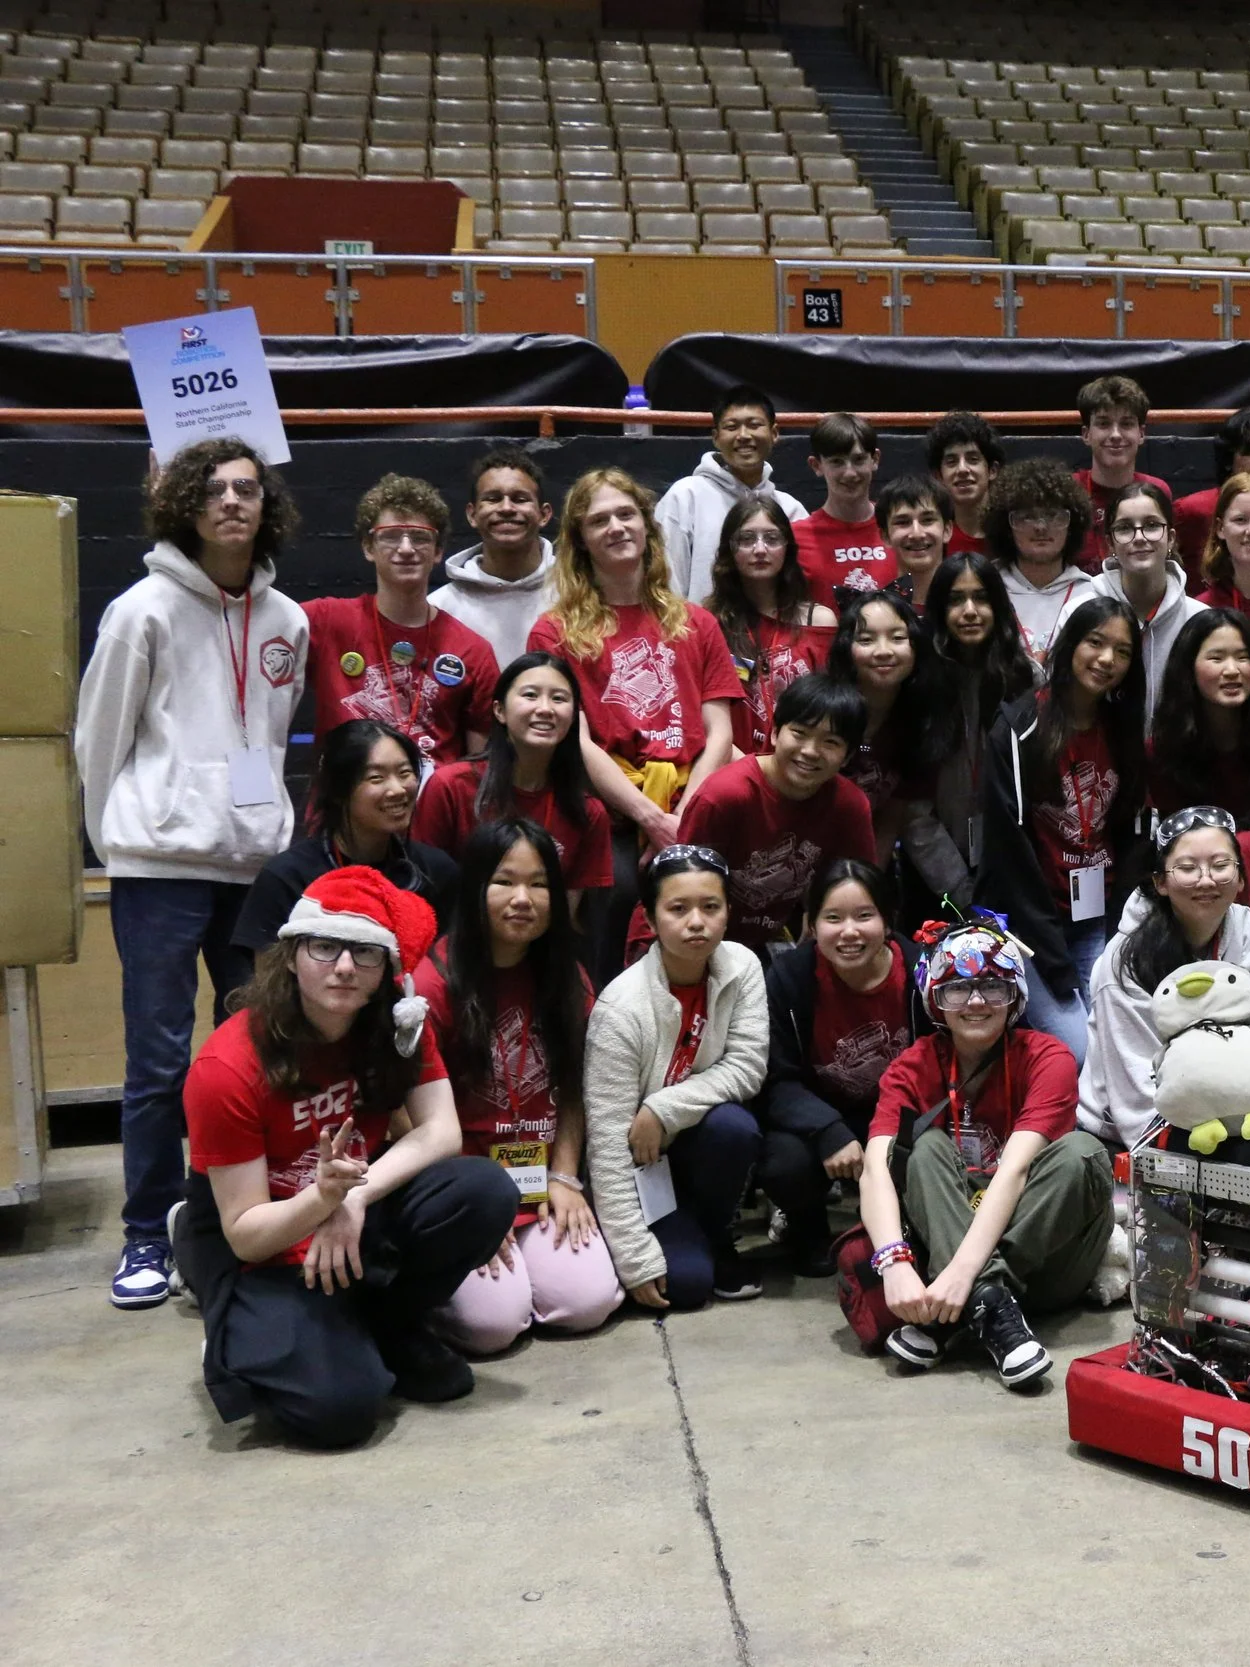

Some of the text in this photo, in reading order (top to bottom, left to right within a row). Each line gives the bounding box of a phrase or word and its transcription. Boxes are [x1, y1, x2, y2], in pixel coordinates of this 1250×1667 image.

[805, 294, 830, 305] Box
[808, 308, 829, 322] 43
[181, 338, 208, 350] FIRST
[171, 368, 238, 399] 5026
[175, 400, 247, 418] Northern California
[175, 409, 252, 429] State Championship
[206, 422, 227, 433] 2026
[834, 545, 887, 563] 5026
[665, 735, 684, 750] 502
[1062, 851, 1080, 864] Iron
[292, 1080, 362, 1133] 502
[497, 1146, 542, 1161] REBUILT
